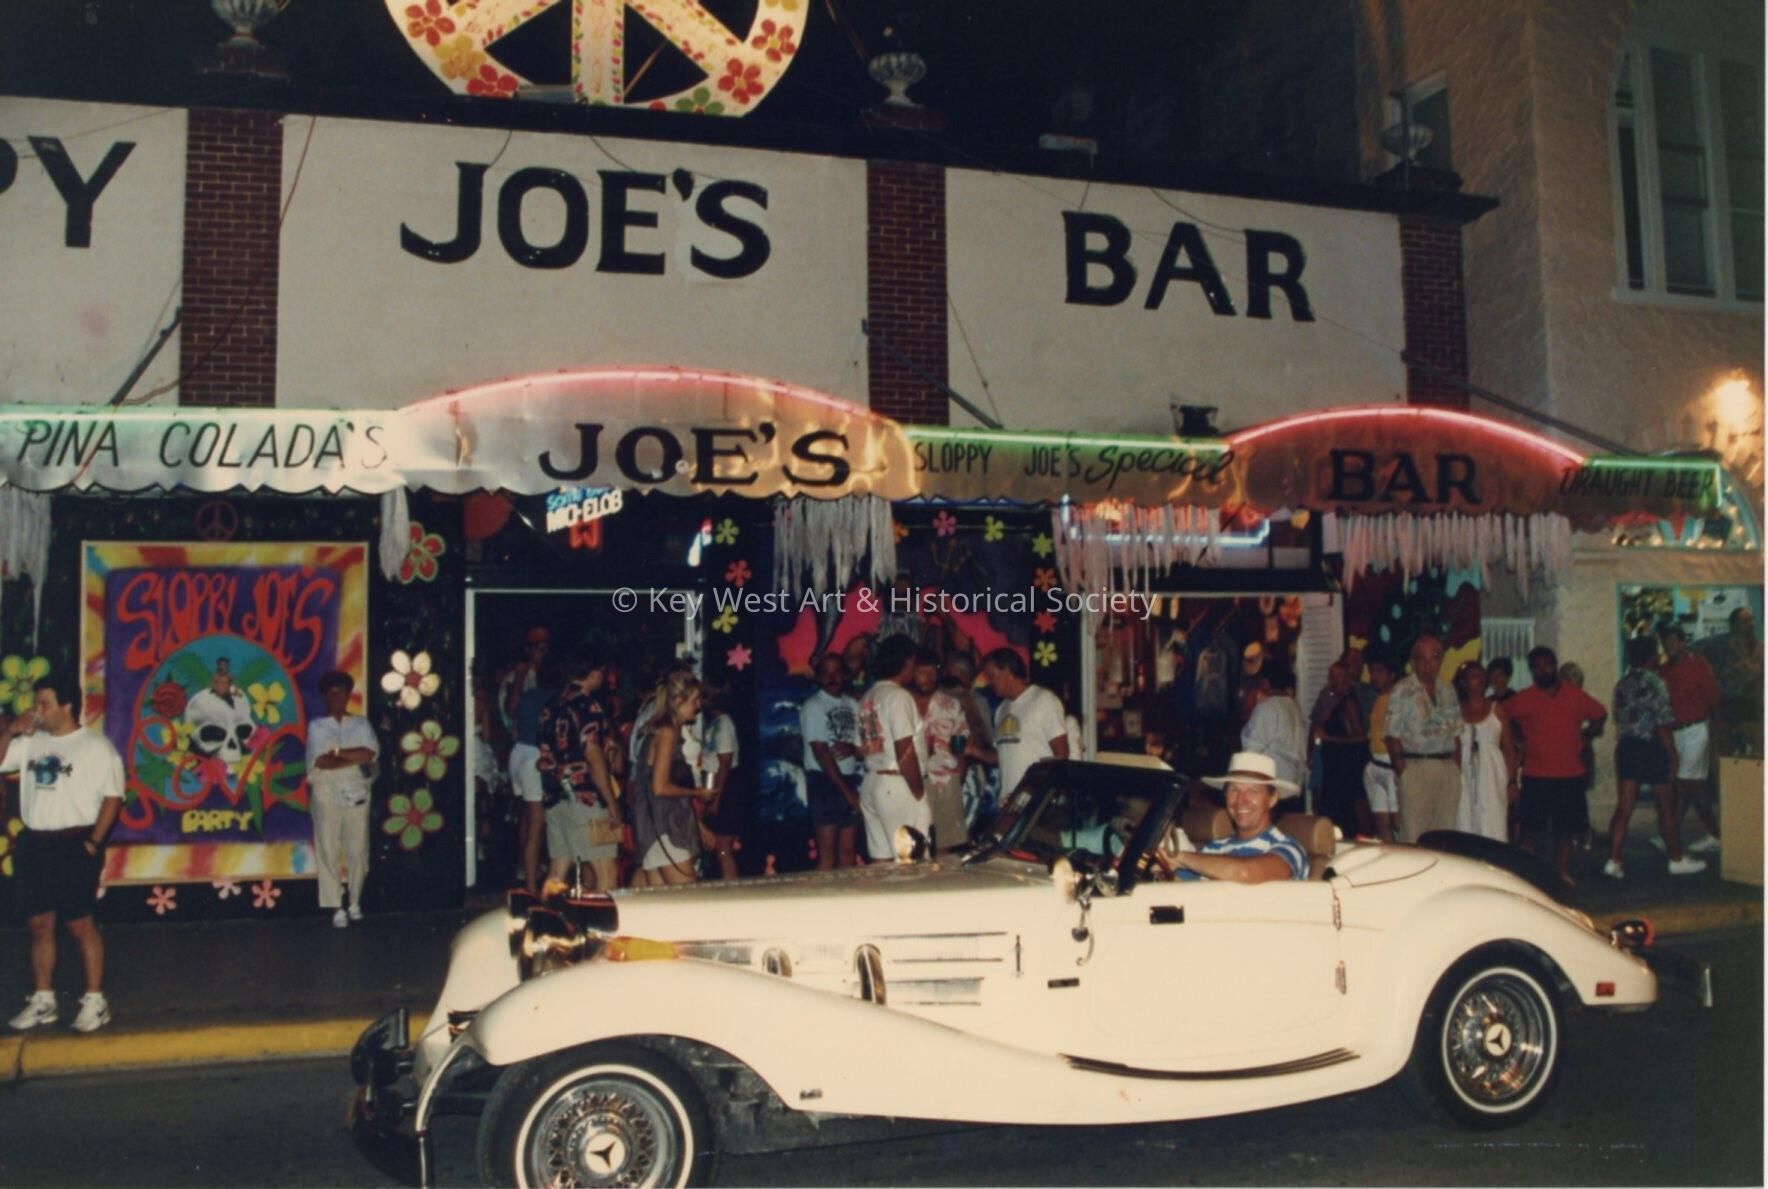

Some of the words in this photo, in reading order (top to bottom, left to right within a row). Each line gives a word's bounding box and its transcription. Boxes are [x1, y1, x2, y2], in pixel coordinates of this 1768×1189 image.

[0, 135, 137, 249] Y
[400, 161, 772, 279] JOE'S
[1061, 209, 1317, 323] BAR
[15, 420, 121, 467] PINA
[158, 421, 388, 470] COLADA'S
[538, 422, 851, 487] JOE'S
[913, 441, 992, 474] SLOPPY
[1024, 444, 1081, 478] JOE'S
[1084, 445, 1235, 491] Special
[1328, 448, 1482, 505] BAR
[1558, 466, 1654, 497] DRAUGHT
[1662, 467, 1716, 498] BEER
[116, 571, 238, 671] SLOPPY
[181, 808, 252, 834] PARTY
